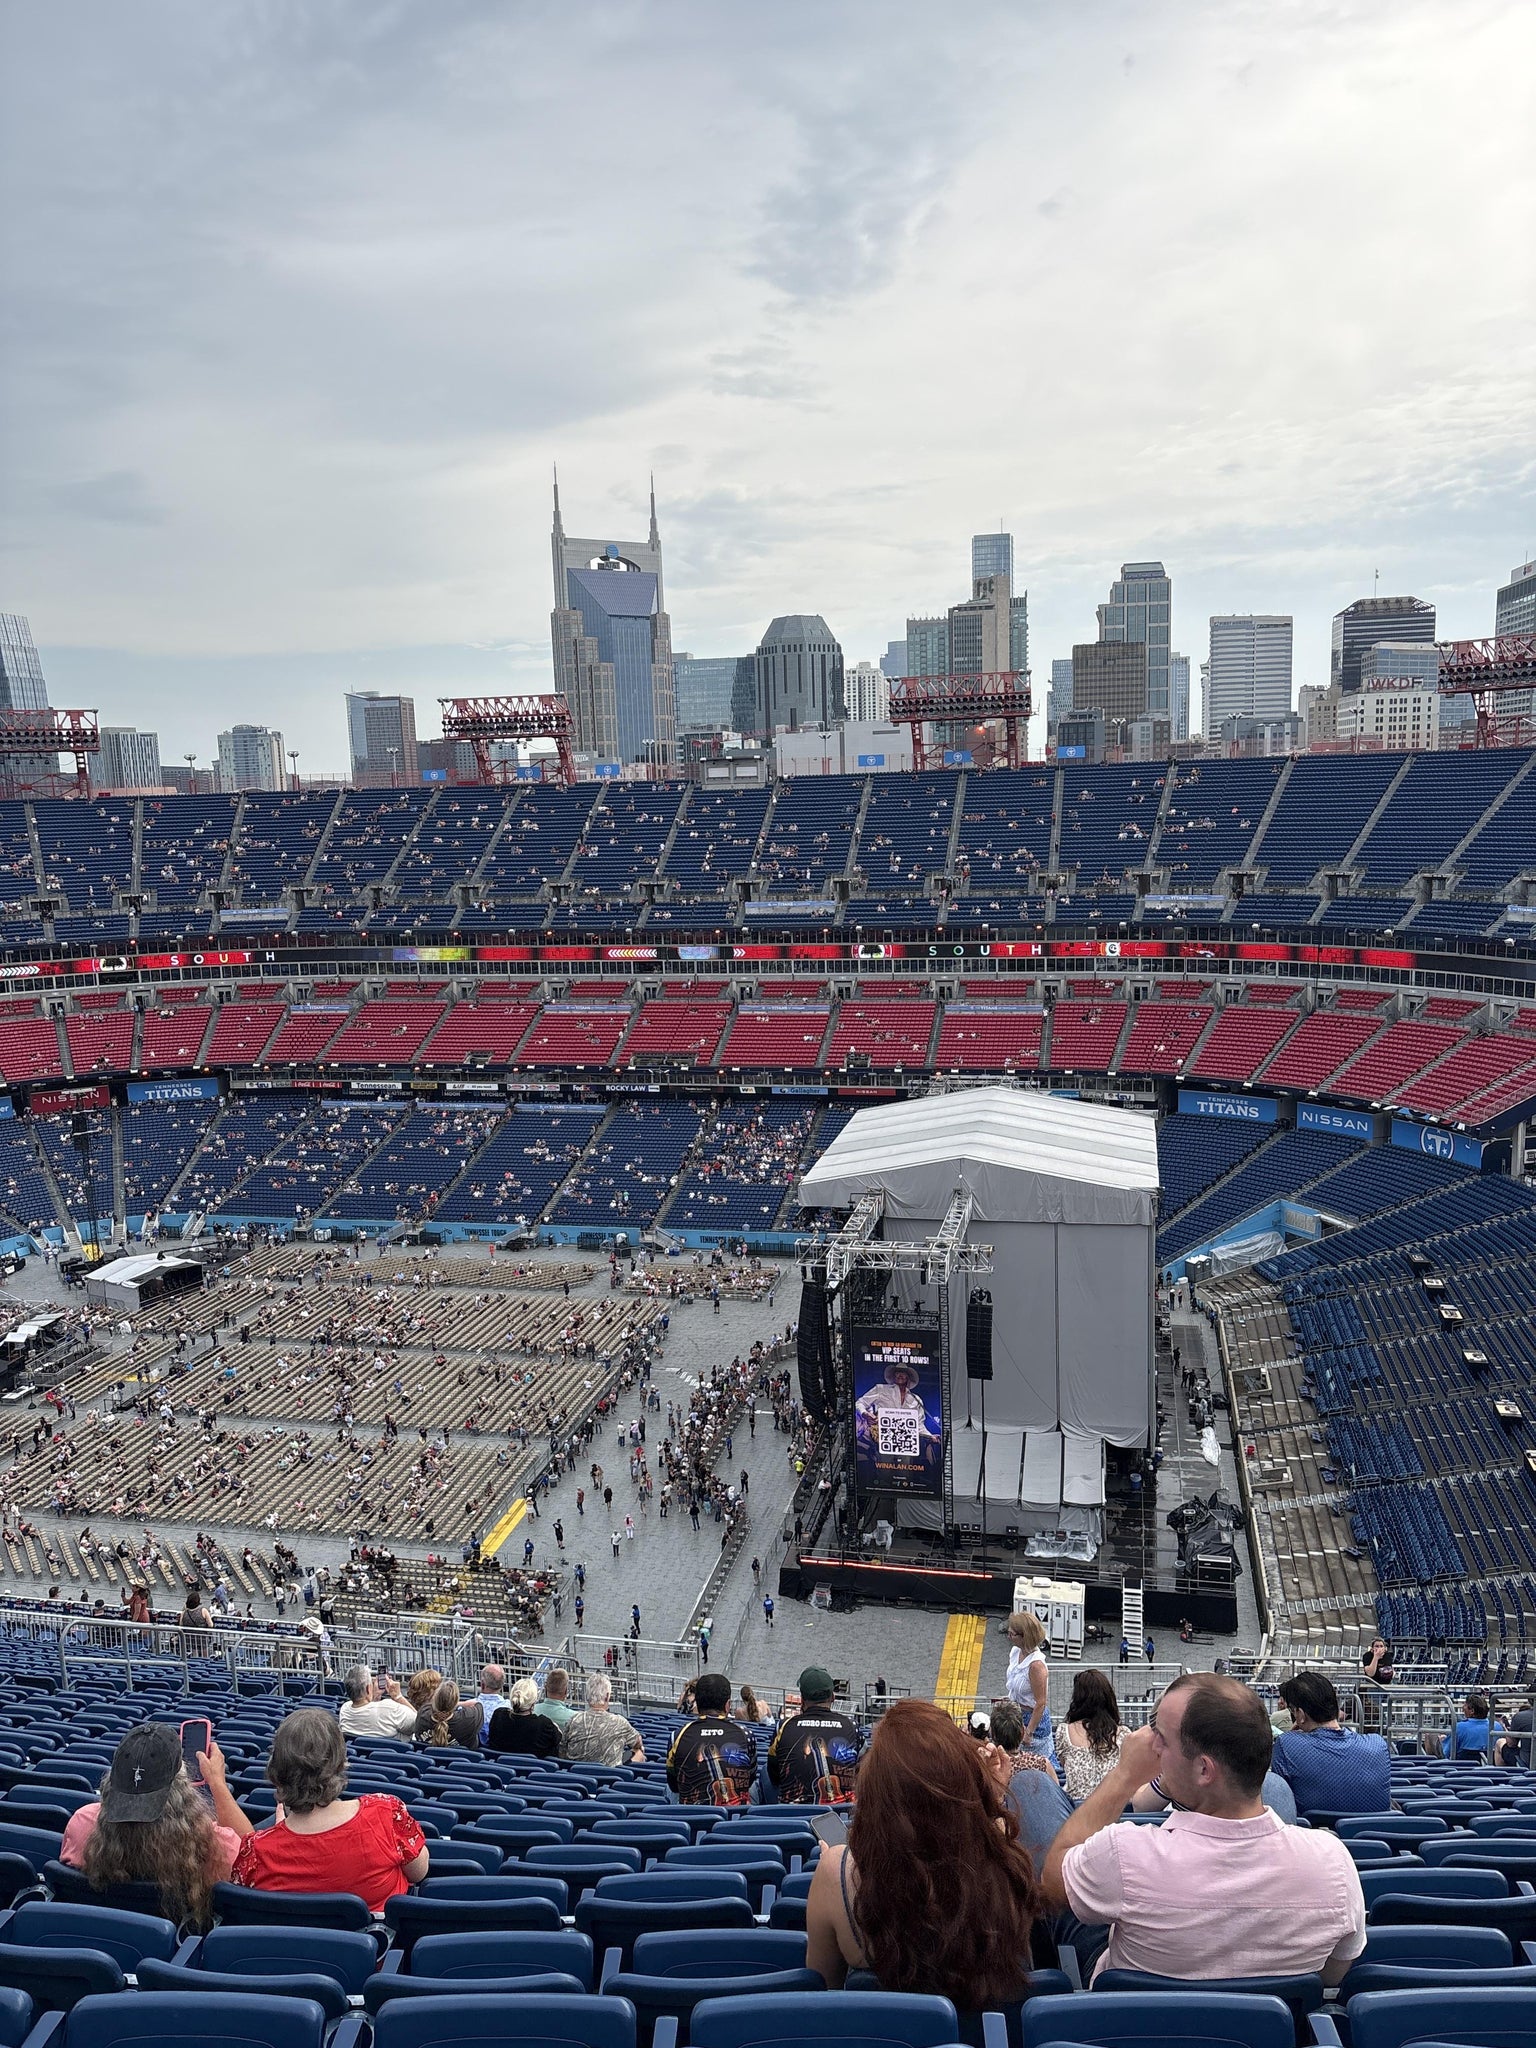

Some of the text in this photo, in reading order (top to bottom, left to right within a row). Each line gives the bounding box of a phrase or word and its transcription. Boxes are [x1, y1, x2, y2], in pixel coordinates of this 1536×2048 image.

[1371, 677, 1424, 690] WKDF
[928, 944, 1042, 956] SOUTH
[170, 951, 276, 966] SOUTH
[144, 1086, 203, 1100] TITANS
[1207, 1096, 1249, 1105] TENNESSEE
[1196, 1101, 1260, 1118] TITANS
[1302, 1111, 1368, 1132] NISSAN
[881, 1346, 911, 1355] VIP SEATS
[864, 1353, 871, 1361] IN
[884, 1354, 900, 1362] FIRST
[901, 1355, 909, 1363] 10
[909, 1356, 930, 1364] ROWS!
[875, 1462, 925, 1471] WINALAN.COM
[796, 1720, 843, 1729] PEDRO SILVA
[700, 1728, 724, 1737] KITO
